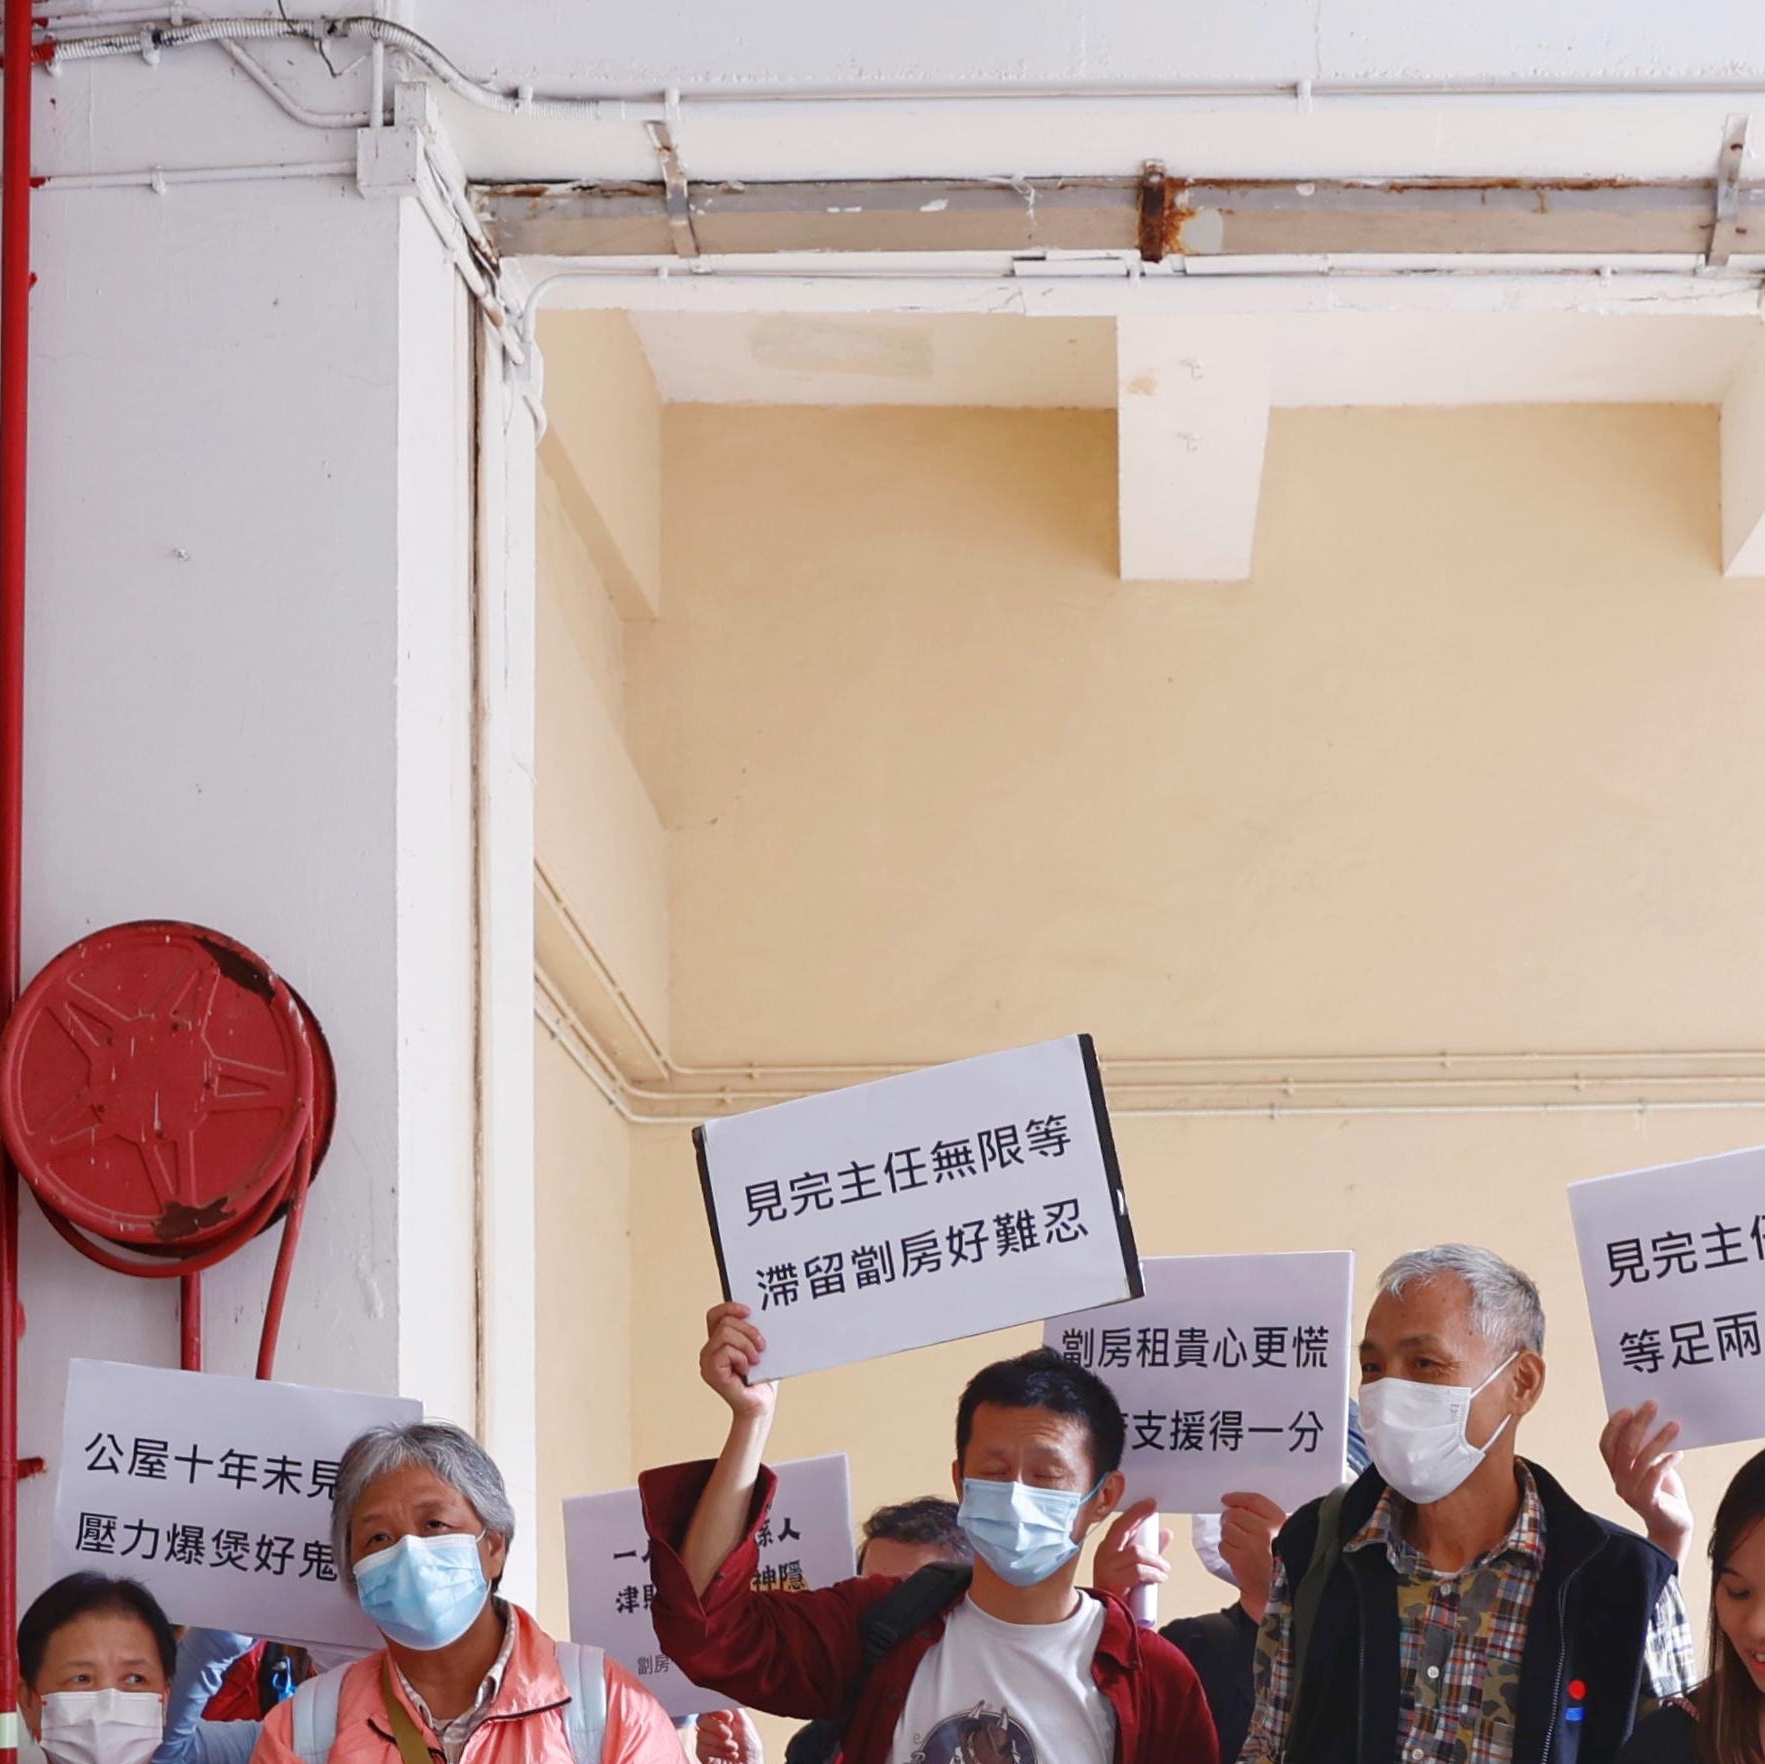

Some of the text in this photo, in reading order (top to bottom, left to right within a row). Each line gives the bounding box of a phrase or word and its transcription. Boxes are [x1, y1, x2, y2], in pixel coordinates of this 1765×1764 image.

[744, 1114, 1072, 1227] 見完主任無限等
[754, 1199, 1089, 1312] 滯留劏房好難忍
[1062, 1326, 1329, 1368] 劏房租貴心更慌
[1121, 1410, 1324, 1452] 支援得一分
[84, 1432, 338, 1500] 公屋十年未見
